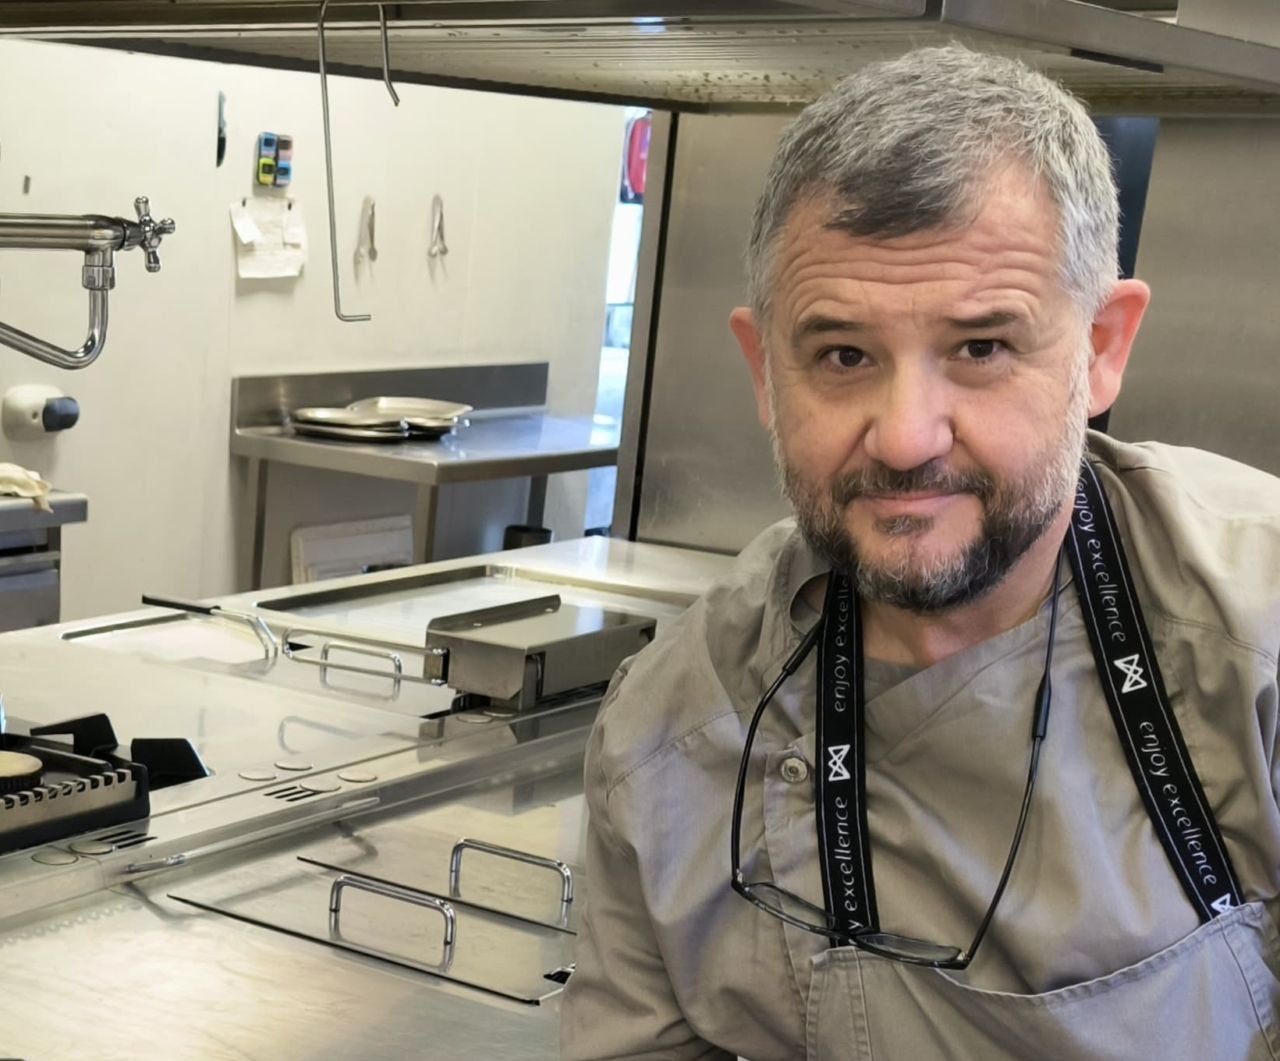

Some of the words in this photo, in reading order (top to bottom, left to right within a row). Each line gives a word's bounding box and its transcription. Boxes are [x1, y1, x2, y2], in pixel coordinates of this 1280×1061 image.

[1086, 538, 1127, 643] excellence
[833, 653, 851, 713] enjoy
[833, 796, 858, 912] excellence
[1139, 720, 1170, 777] enjoy
[1162, 783, 1217, 886] excellence
